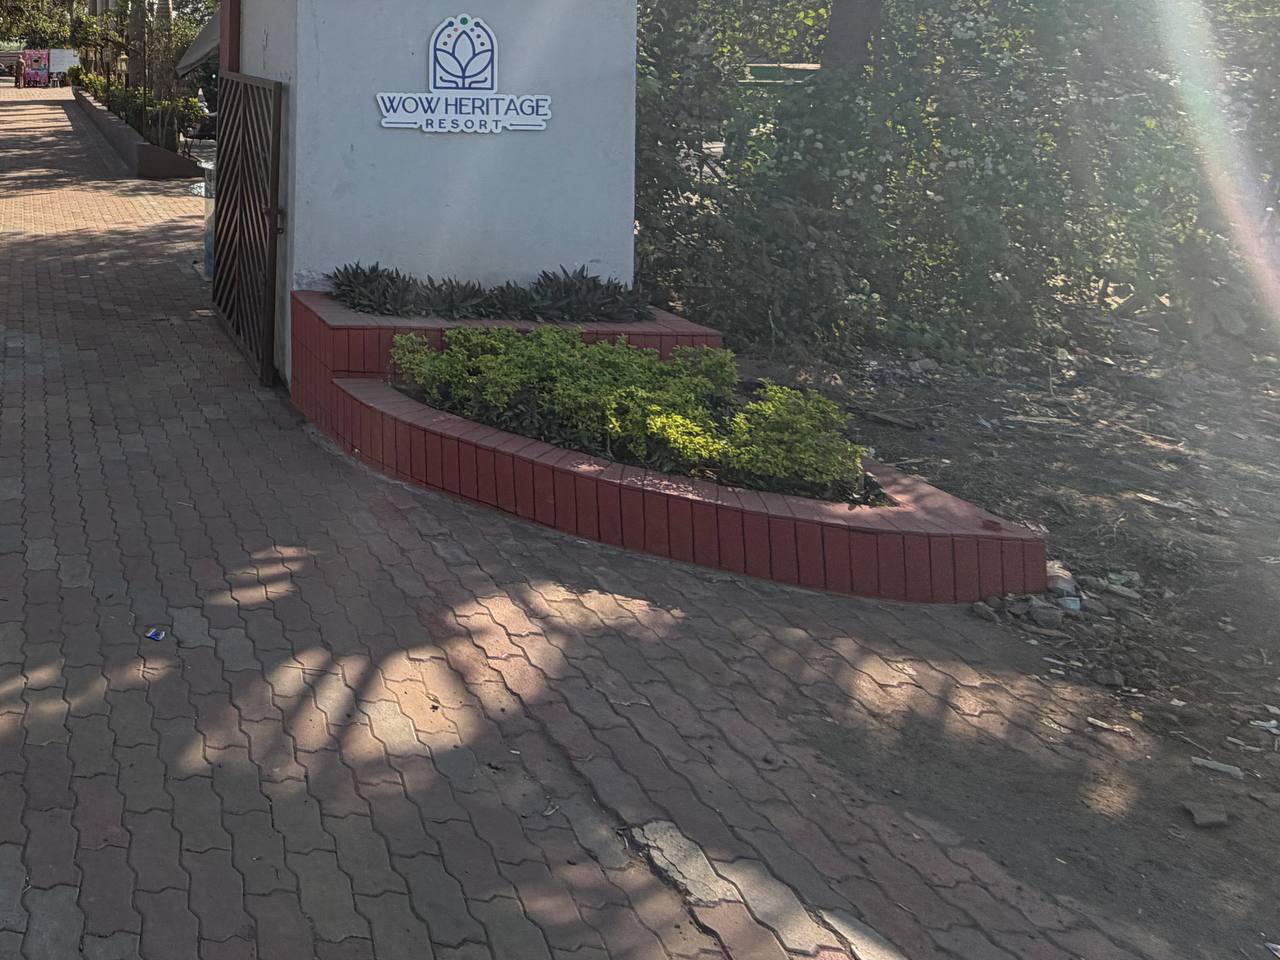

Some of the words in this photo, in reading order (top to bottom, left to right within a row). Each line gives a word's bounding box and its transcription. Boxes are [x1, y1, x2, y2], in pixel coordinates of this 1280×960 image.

[380, 96, 441, 115] WOW
[445, 97, 549, 117] HERITAGE
[425, 118, 502, 130] RESORT
